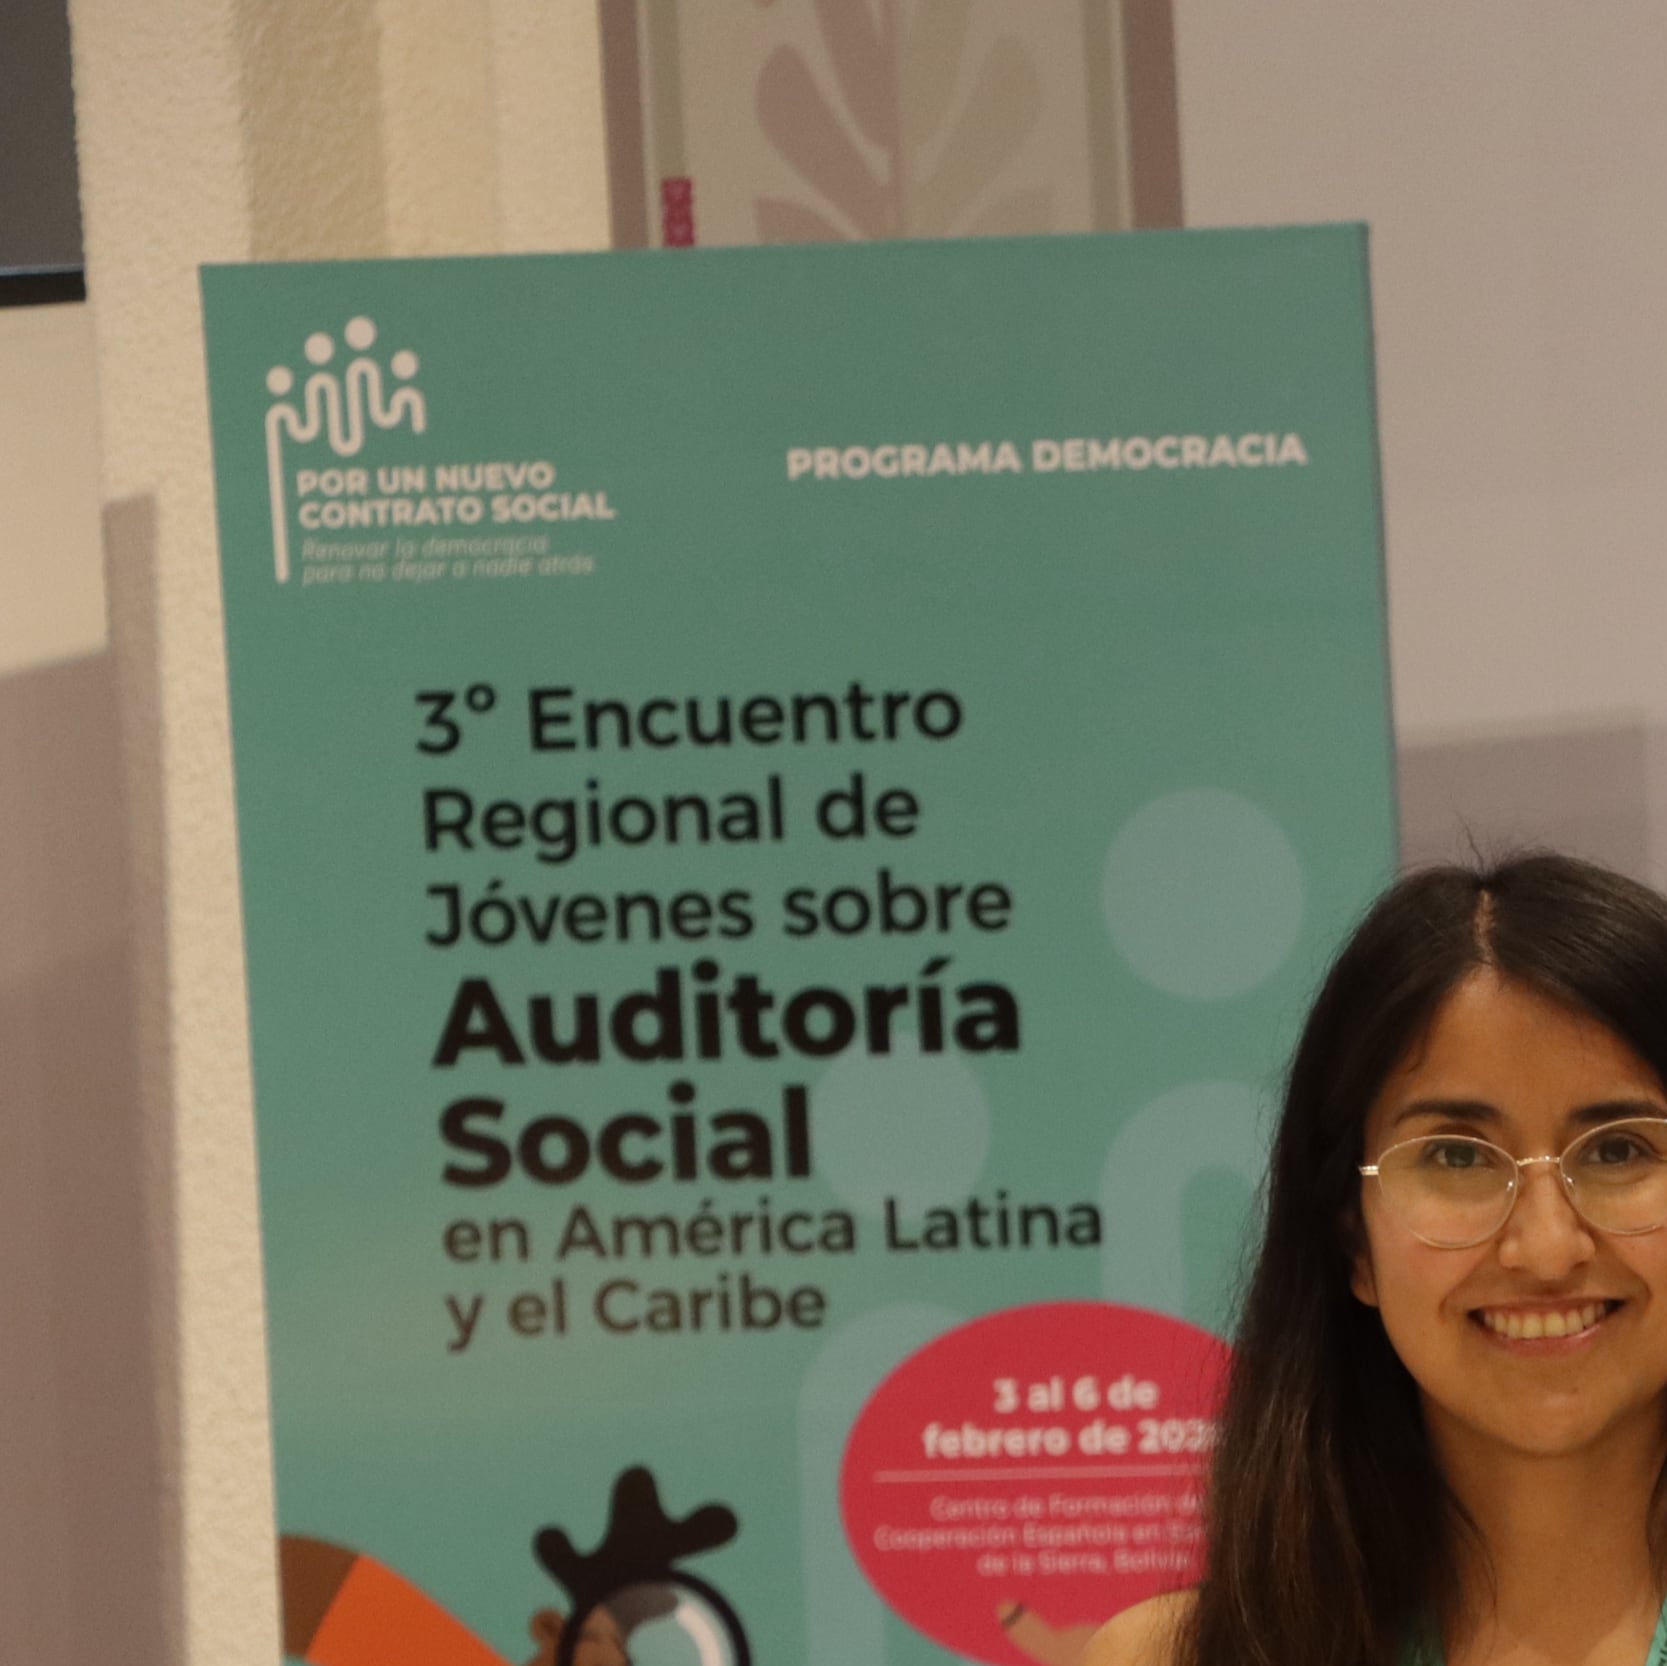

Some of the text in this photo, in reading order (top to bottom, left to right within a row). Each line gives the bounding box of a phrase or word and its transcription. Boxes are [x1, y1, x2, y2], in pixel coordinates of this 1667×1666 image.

[788, 433, 1307, 482] PROGRAMA DEMOCRACIA
[297, 461, 555, 496] POR UN NUEVO
[299, 492, 617, 529] CONTRATO SOCIAL
[302, 534, 549, 560] Renovar la democracia
[303, 554, 594, 586] para no dejar a nadie atrás
[529, 682, 962, 751] Encuentro
[421, 771, 919, 865] Regional de
[426, 869, 1012, 948] Jóvenes sobre
[432, 957, 1022, 1069] Auditoría
[438, 1081, 811, 1189] Social
[444, 1191, 1104, 1264] en América Latina
[445, 1273, 826, 1354] y el Caribe
[994, 1374, 1159, 1414] 3 al 6 de
[923, 1422, 1070, 1459] febrero
[1078, 1419, 1130, 1456] de
[930, 1496, 1007, 1522] Centro
[1013, 1495, 1041, 1519] de
[1048, 1491, 1169, 1518] Formación
[873, 1524, 1016, 1552] Cooperación
[1023, 1521, 1126, 1548] Española
[1133, 1524, 1160, 1545] en
[977, 1553, 1007, 1577] de
[1013, 1552, 1033, 1575] la
